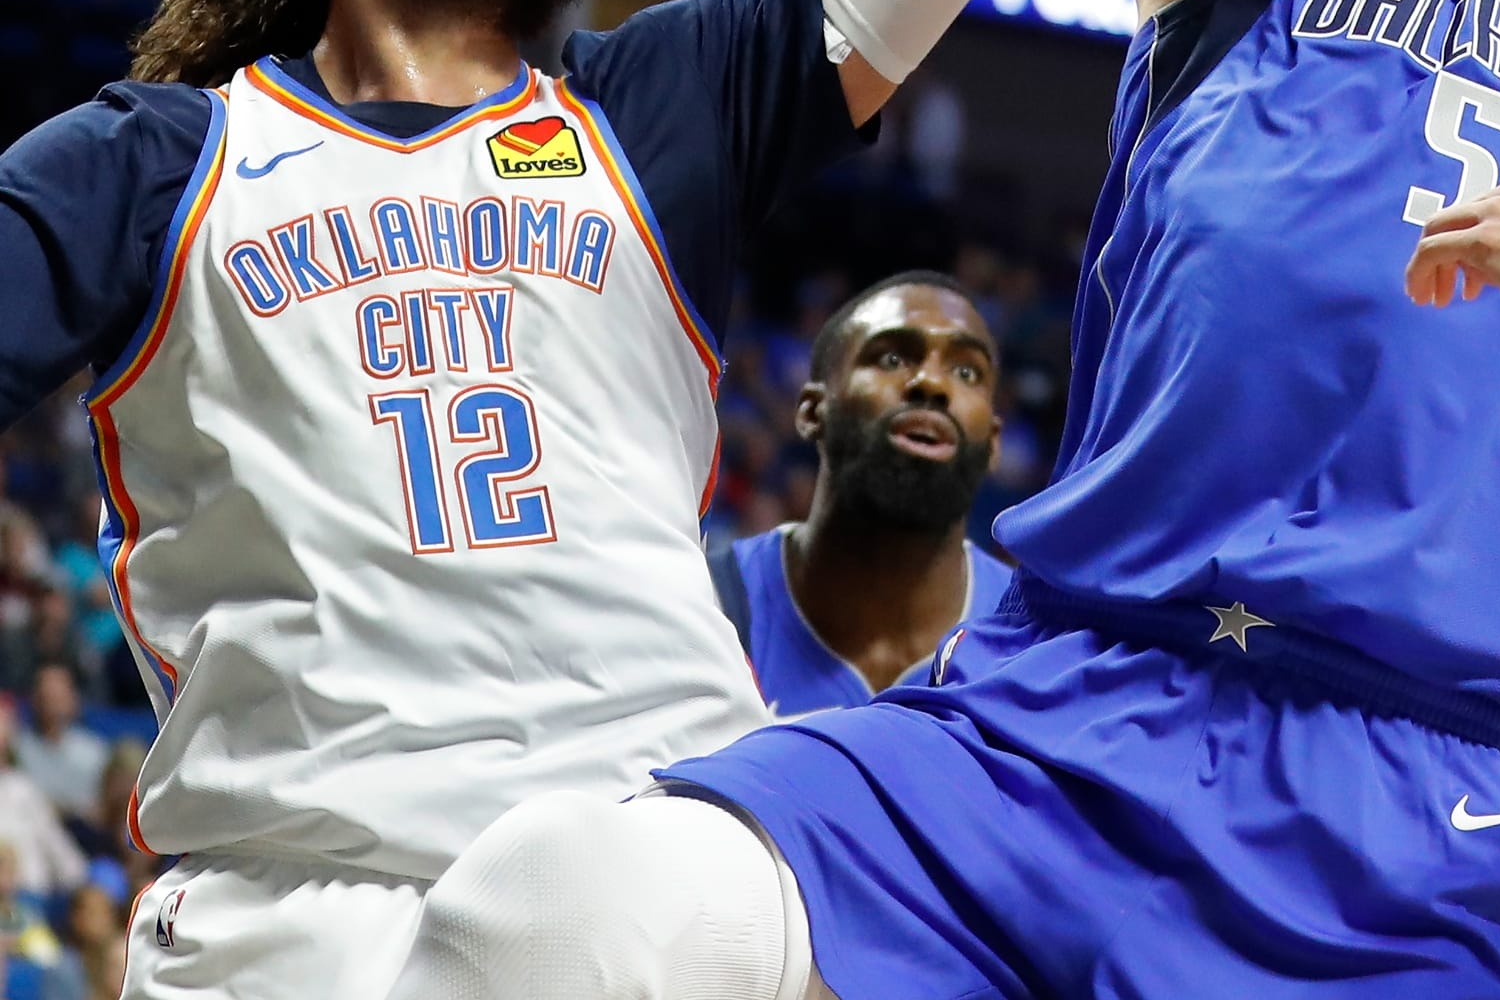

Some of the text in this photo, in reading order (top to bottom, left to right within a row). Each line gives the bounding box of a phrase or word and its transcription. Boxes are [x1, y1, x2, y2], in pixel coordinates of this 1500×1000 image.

[223, 196, 616, 318] OKLAHOMA
[355, 287, 514, 379] CITY
[367, 384, 557, 555] 12
